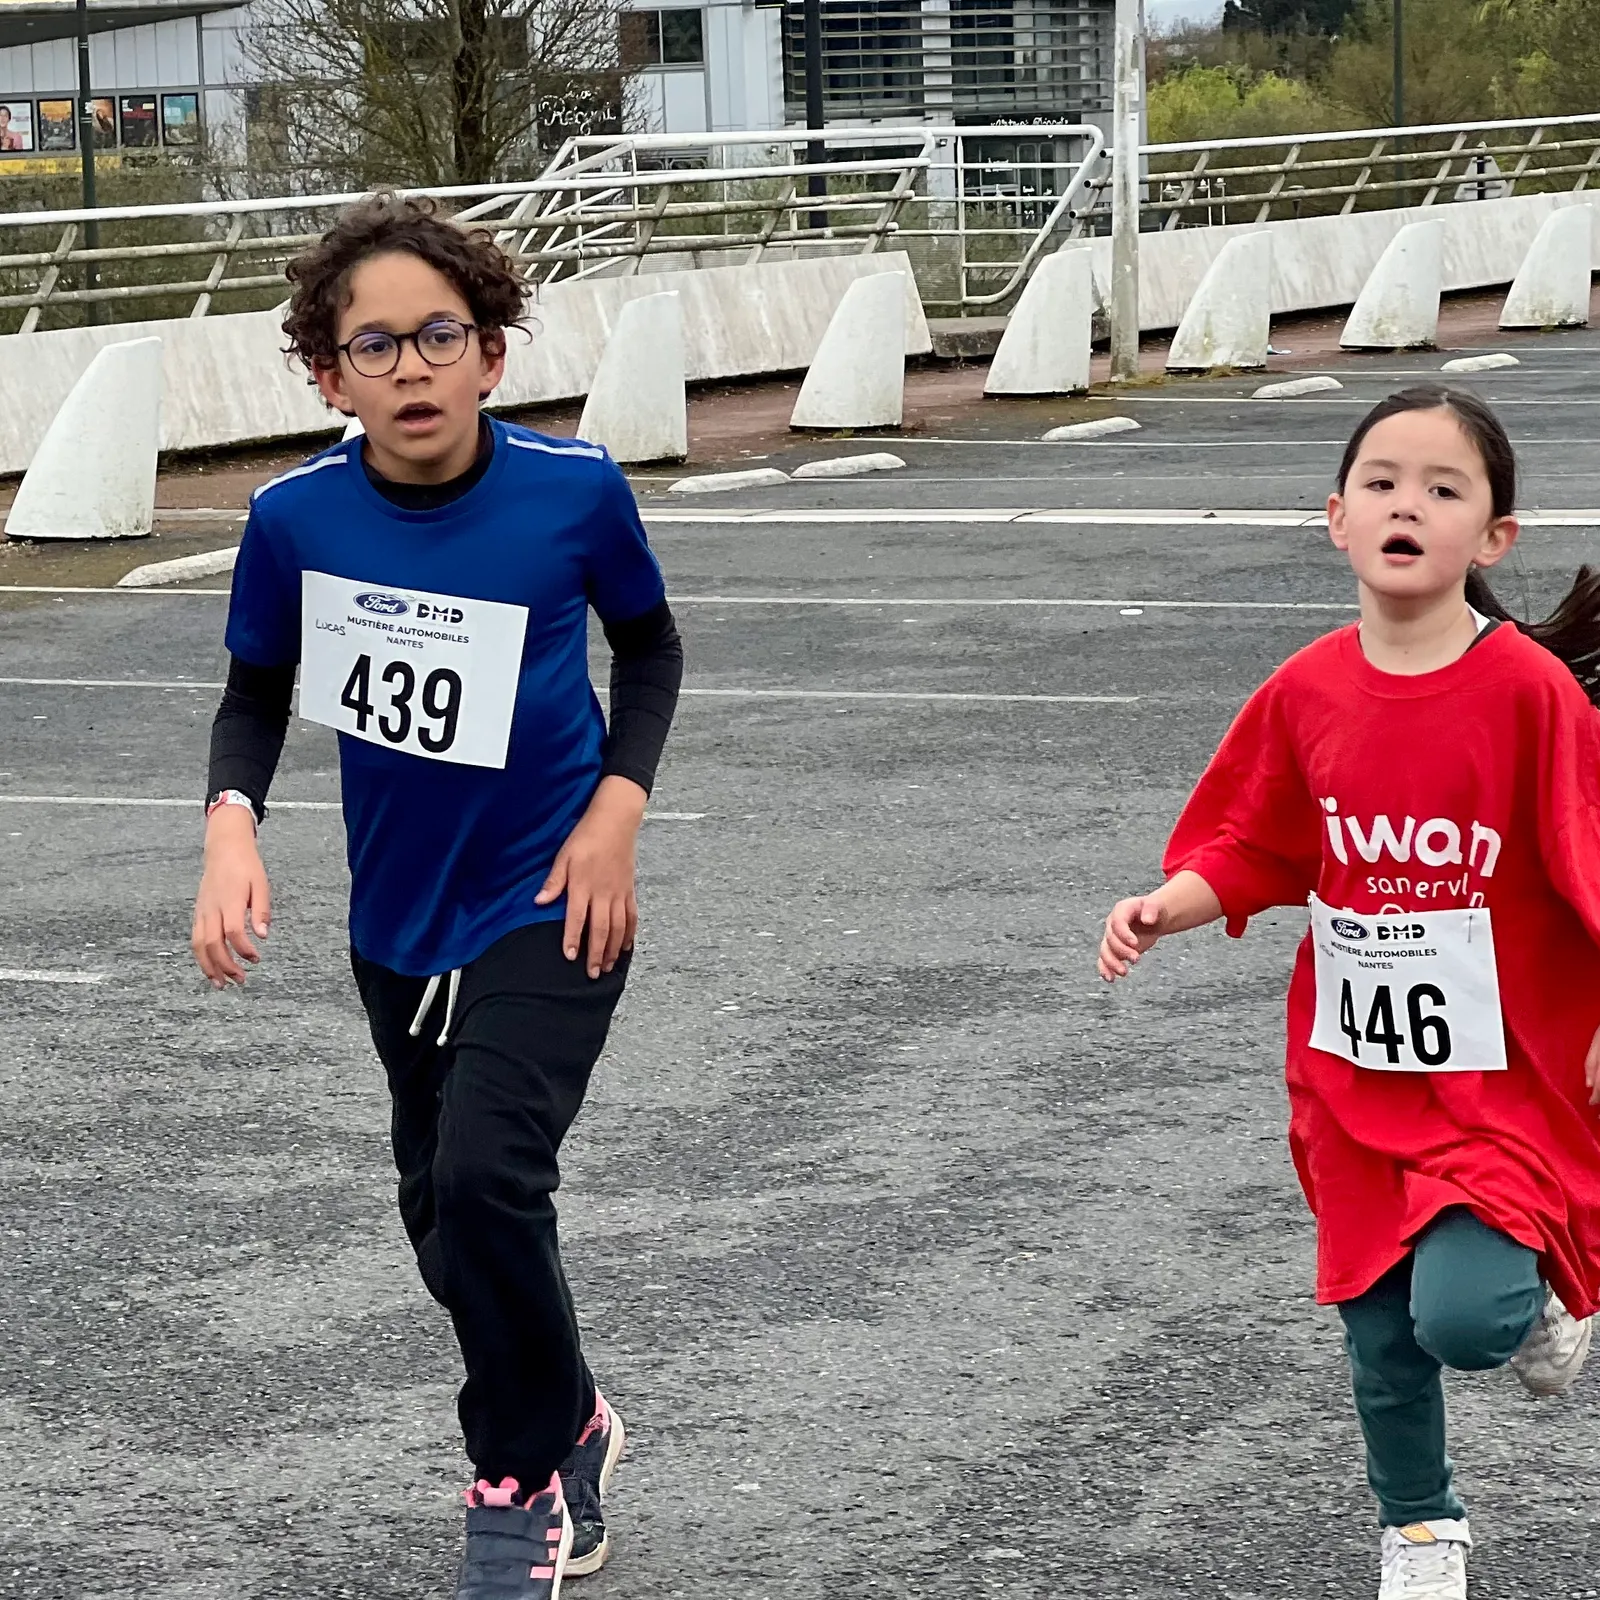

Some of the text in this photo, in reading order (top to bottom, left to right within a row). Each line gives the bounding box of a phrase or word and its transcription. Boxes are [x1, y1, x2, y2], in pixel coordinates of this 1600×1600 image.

[363, 595, 399, 613] Ford
[416, 603, 464, 623] DMD
[315, 618, 346, 636] LUCAS
[346, 615, 470, 644] MUSTIÈRE AUTOMOBILES
[386, 636, 425, 649] NANTES
[340, 653, 462, 753] 439
[1319, 796, 1502, 878] iwan
[1335, 921, 1425, 940] Ford DMD
[1330, 940, 1362, 957] MUSTIÈRE
[1364, 948, 1437, 958] AUTOMOBILES
[1358, 961, 1394, 969] NANTES
[1339, 977, 1452, 1066] 446
